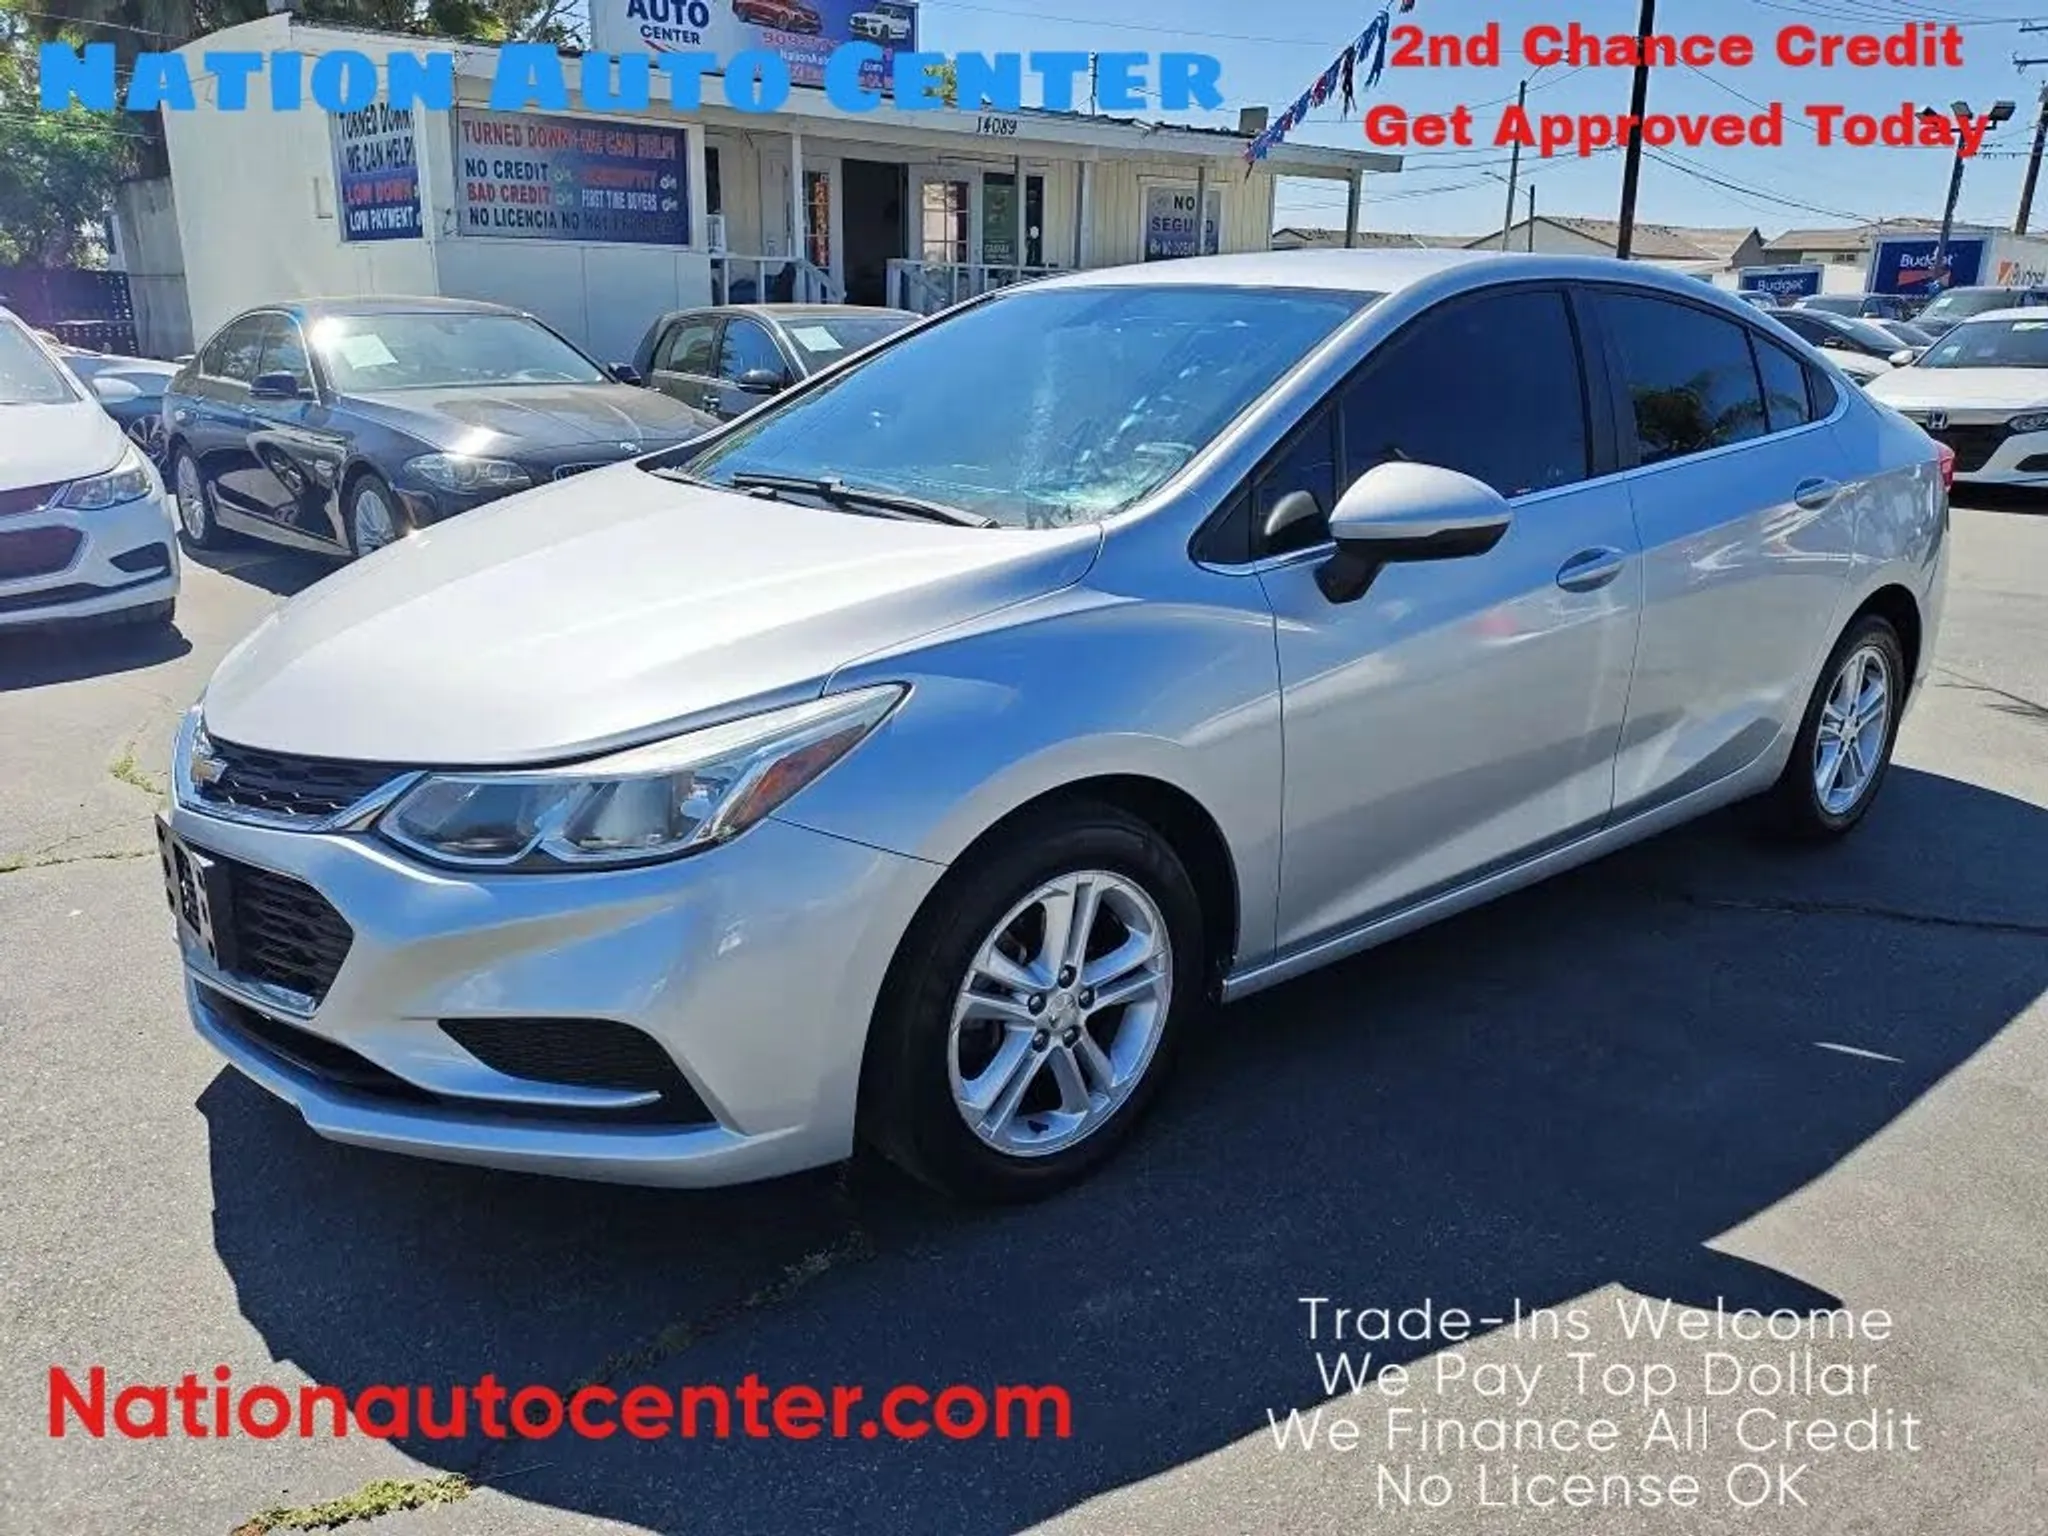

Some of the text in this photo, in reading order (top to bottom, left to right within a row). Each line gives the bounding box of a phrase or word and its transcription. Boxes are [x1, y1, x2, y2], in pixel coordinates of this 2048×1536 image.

[626, 0, 711, 29] AUTO
[640, 24, 702, 45] CENTER
[462, 119, 523, 147] TURNED
[976, 115, 1018, 135] 14089
[464, 157, 488, 178] NO
[493, 159, 549, 182] CREDIT
[466, 182, 496, 203] BAD
[500, 184, 552, 205] CREDIT
[1174, 195, 1196, 211] NO
[469, 206, 490, 227] NO
[493, 207, 558, 229] LICENCIA
[561, 211, 580, 231] NO
